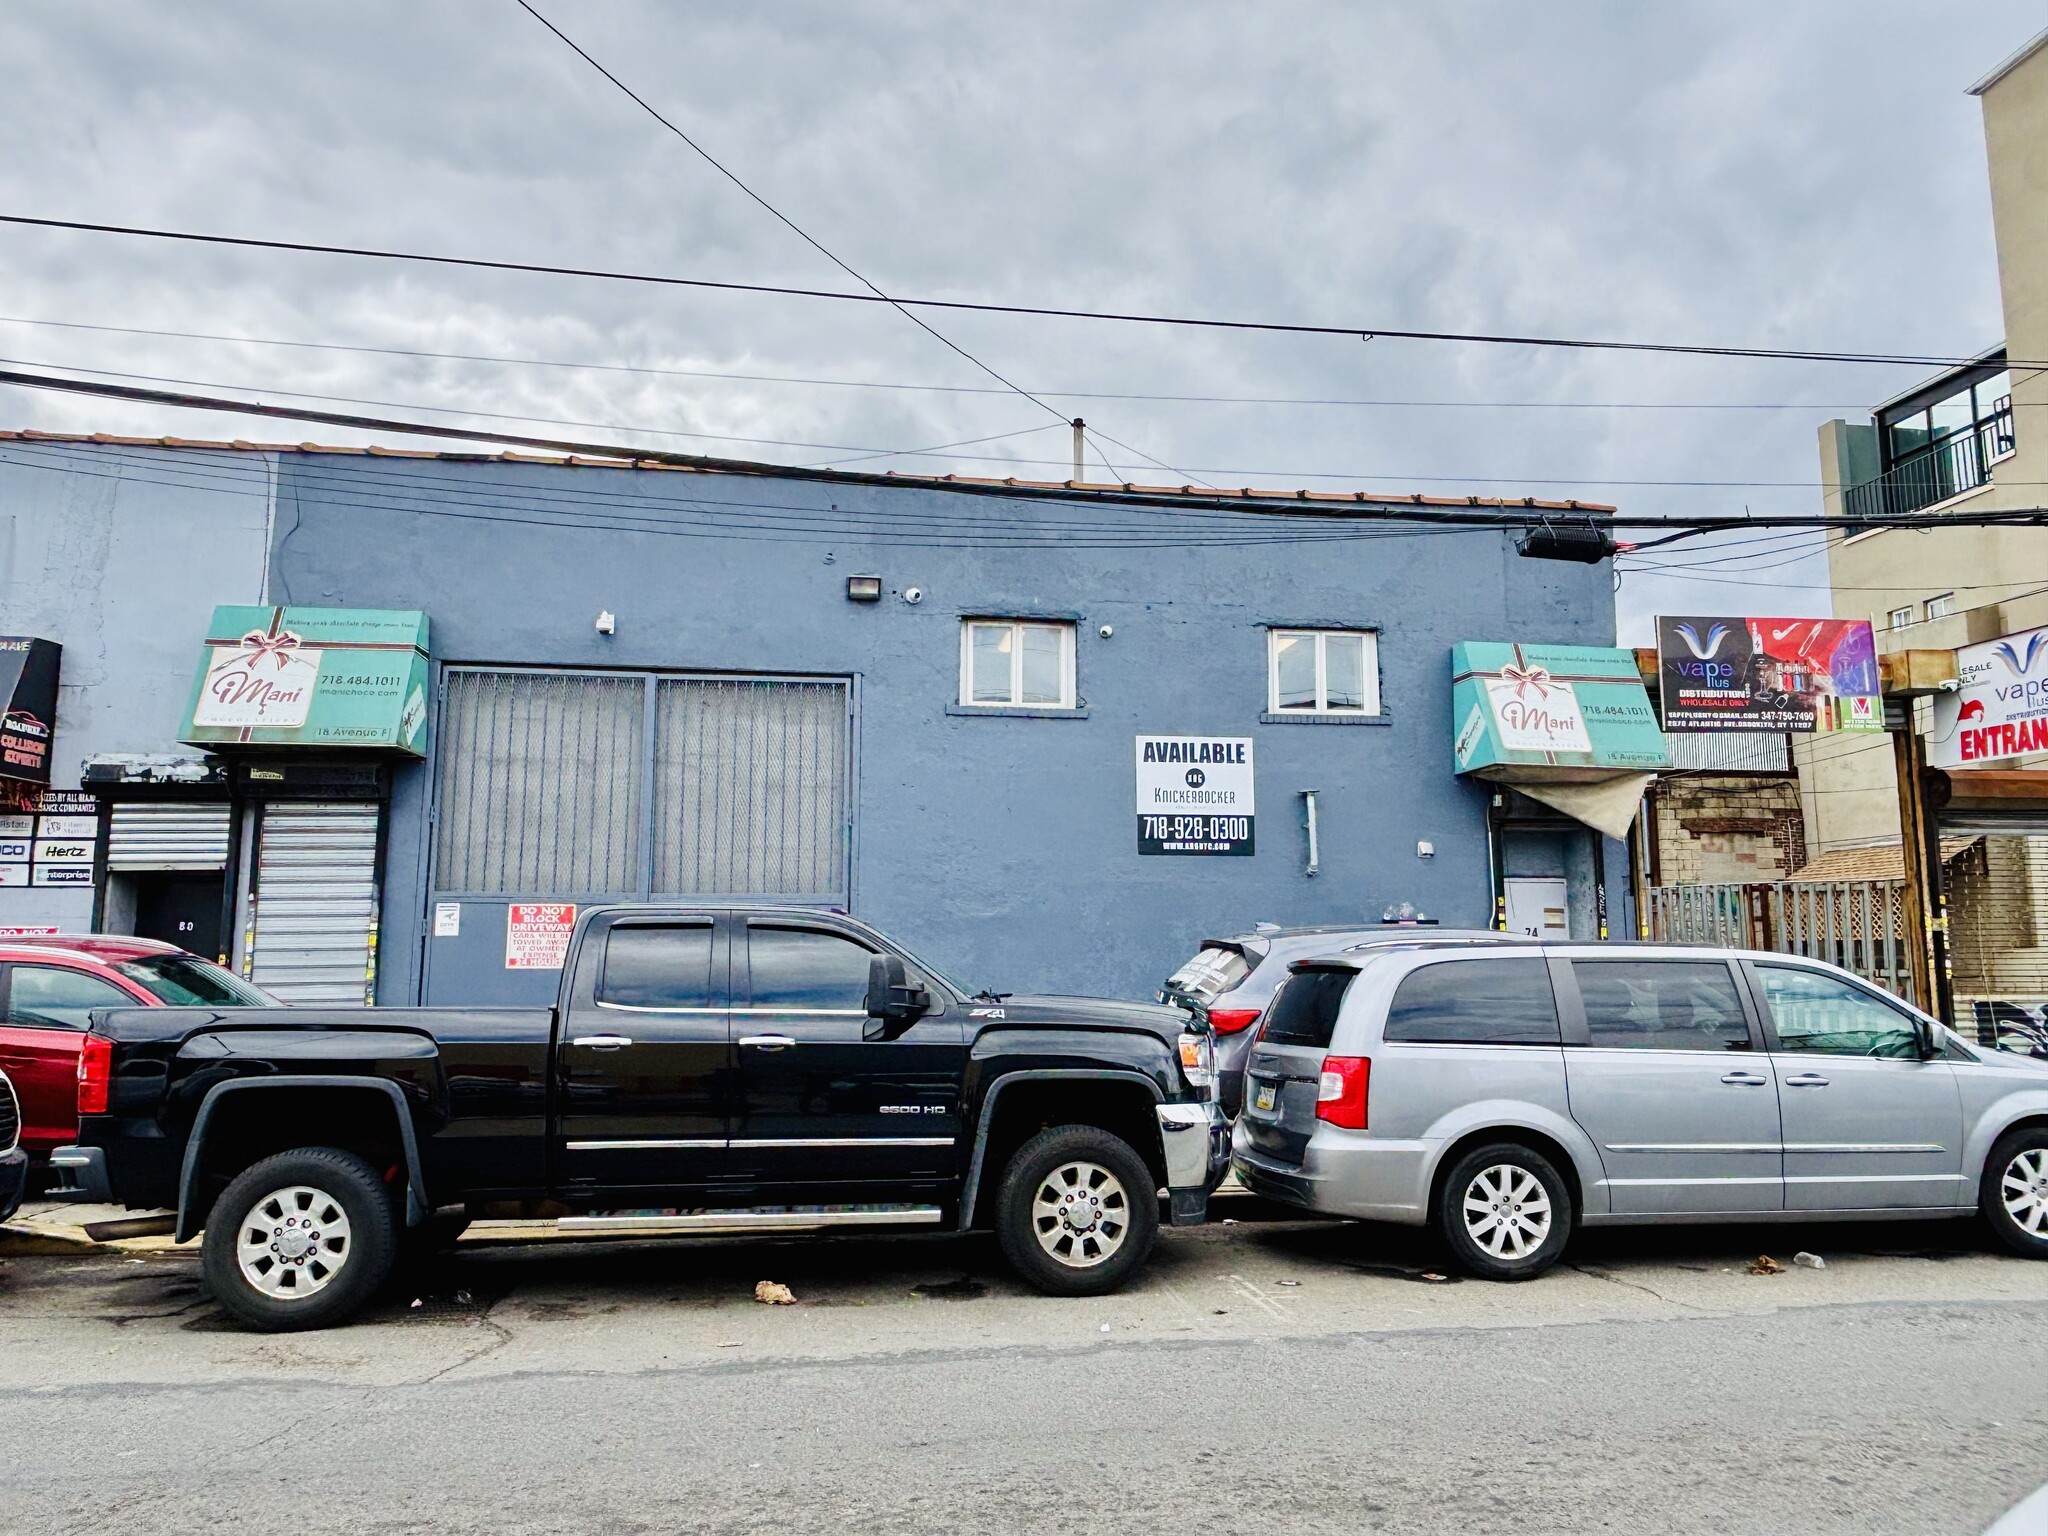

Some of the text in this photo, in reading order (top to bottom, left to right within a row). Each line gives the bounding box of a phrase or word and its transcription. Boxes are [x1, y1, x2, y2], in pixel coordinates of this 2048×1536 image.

[1677, 662, 1733, 685] vape
[321, 675, 400, 686] 718.484.1011
[212, 671, 303, 711] iMani
[1679, 690, 1745, 698] DISTRIBUTION
[1582, 706, 1649, 716] 718.484.1011
[1761, 711, 1814, 721] 347-750-7490
[1501, 701, 1574, 737] iMani
[333, 728, 378, 737] Avenue
[1961, 717, 2048, 760] ENTRAN
[1143, 741, 1246, 764] AVAILABLE
[1620, 753, 1656, 761] Avenue
[1154, 787, 1236, 804] KNICKERBOCKER
[1143, 816, 1248, 840] 718-928-0300
[45, 845, 88, 857] Hertz
[519, 906, 566, 915] DO NOT
[523, 915, 560, 923] BLOCK
[512, 923, 570, 931] DRIVEWAY
